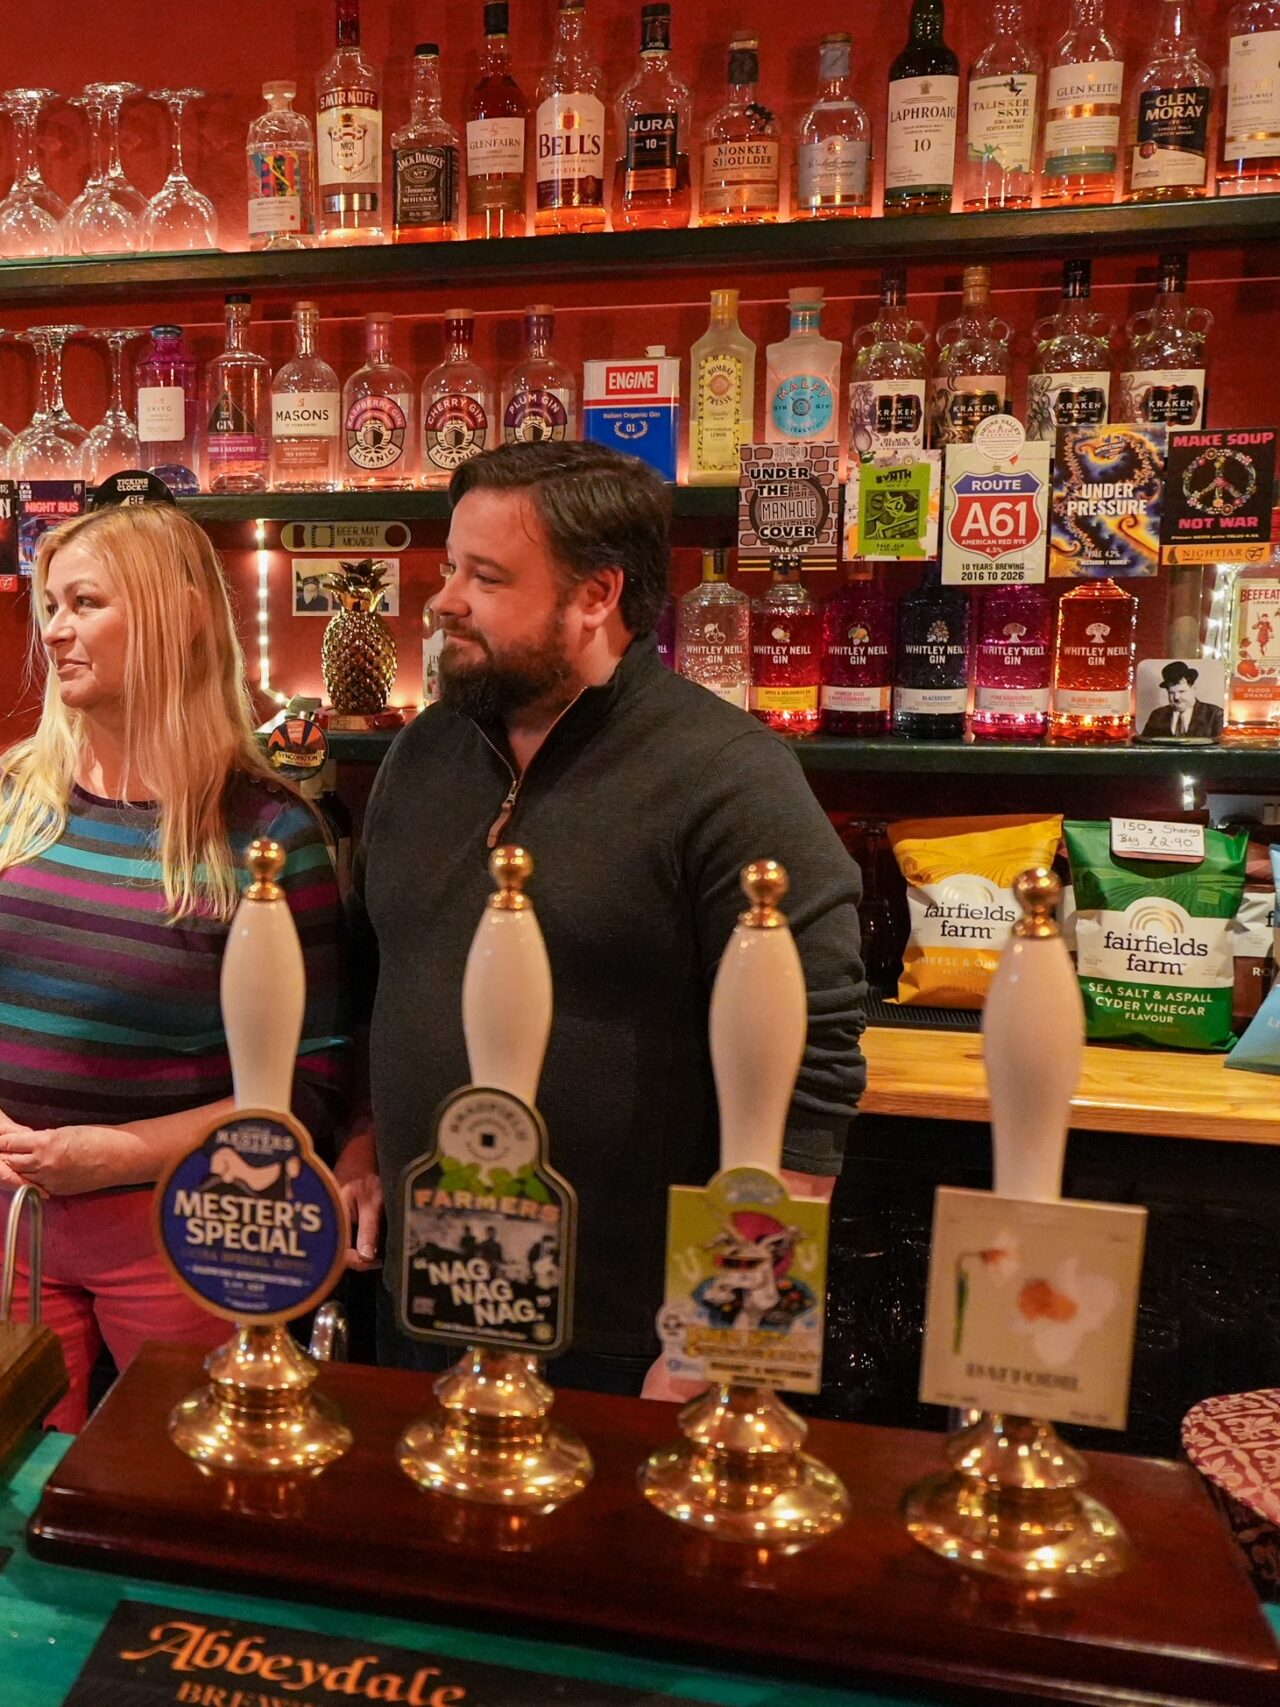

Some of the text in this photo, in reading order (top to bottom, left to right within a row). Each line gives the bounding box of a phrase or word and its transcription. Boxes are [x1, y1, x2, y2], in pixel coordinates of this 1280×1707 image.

[1057, 86, 1085, 97] GLEN
[1088, 83, 1119, 93] KEITH
[320, 91, 376, 109] SMIRNOFF
[972, 99, 1030, 112] TALISKER
[1155, 93, 1196, 107] GLEN
[890, 106, 956, 123] LAPHROAIG
[997, 107, 1030, 118] SKYE
[1145, 105, 1204, 121] MORAY
[629, 119, 675, 132] JURA
[470, 139, 521, 149] GLENFAIRN
[539, 134, 600, 158] BELL'S
[718, 145, 768, 155] MONKEY
[914, 138, 931, 152] 10
[397, 152, 445, 171] JACK DANIEL'S
[712, 157, 772, 167] SHOULDER
[708, 364, 734, 376] BOMBAY
[608, 370, 656, 389] ENGINE
[508, 394, 538, 415] PLUM
[1058, 401, 1102, 410] KRAKEN
[1148, 400, 1194, 408] KRAKEN
[276, 409, 329, 421] MASONS
[427, 398, 467, 426] CHERRY
[603, 411, 647, 421] Italian Organic
[877, 408, 917, 416] KRAKEN
[216, 420, 234, 431] GIN
[1173, 432, 1274, 447] MAKE SOUP
[354, 447, 396, 464] TITANIC
[433, 449, 477, 464] TITANIC
[750, 467, 809, 480] UNDER
[876, 469, 912, 484] SYNTH
[117, 478, 148, 486] TICKING
[971, 480, 1021, 491] ROUTE
[757, 485, 788, 496] THE
[1081, 483, 1135, 499] UNDER
[25, 501, 79, 513] NIGHT BUS
[762, 499, 816, 520] MANHOLE
[1067, 499, 1148, 516] PRESSURE
[960, 501, 1028, 538] A61
[1178, 516, 1259, 529] NOT WAR
[336, 526, 380, 536] BEER MAT
[759, 526, 815, 538] COVER
[343, 537, 374, 547] MOVIES
[1182, 549, 1242, 559] NIGHTJAR
[971, 563, 1024, 571] YEARS BREWING
[961, 572, 1024, 581] 2016 TO 2026
[686, 645, 743, 655] WHITLEY NEILL
[753, 646, 811, 655] WHITLEY NEILL
[828, 646, 888, 655] WHITLEY NEILL
[905, 645, 967, 655] WHITLEY NEILL
[982, 646, 1044, 656] WHITLEY NEILL
[1064, 647, 1128, 656] WHITLEY NEILL
[772, 655, 789, 664] GIN
[850, 656, 866, 665] GIN
[929, 655, 946, 664] GIN
[1004, 656, 1021, 665] GIN
[1088, 656, 1106, 666] GIN
[923, 902, 1016, 922] fairfields
[940, 920, 992, 940] farm
[1103, 931, 1209, 957] fairfields
[1126, 953, 1183, 976] farm
[1088, 983, 1213, 1003] SEA SALT & ASPALL
[1095, 996, 1206, 1016] CYDER VINEGAR
[1125, 1013, 1174, 1024] FLAVOUR
[174, 1190, 322, 1233] MESTER'S
[414, 1188, 561, 1223] FARMERS
[185, 1218, 307, 1257] SPECIAL
[451, 1278, 514, 1305] NAG
[120, 1620, 467, 1706] Abbeydale
